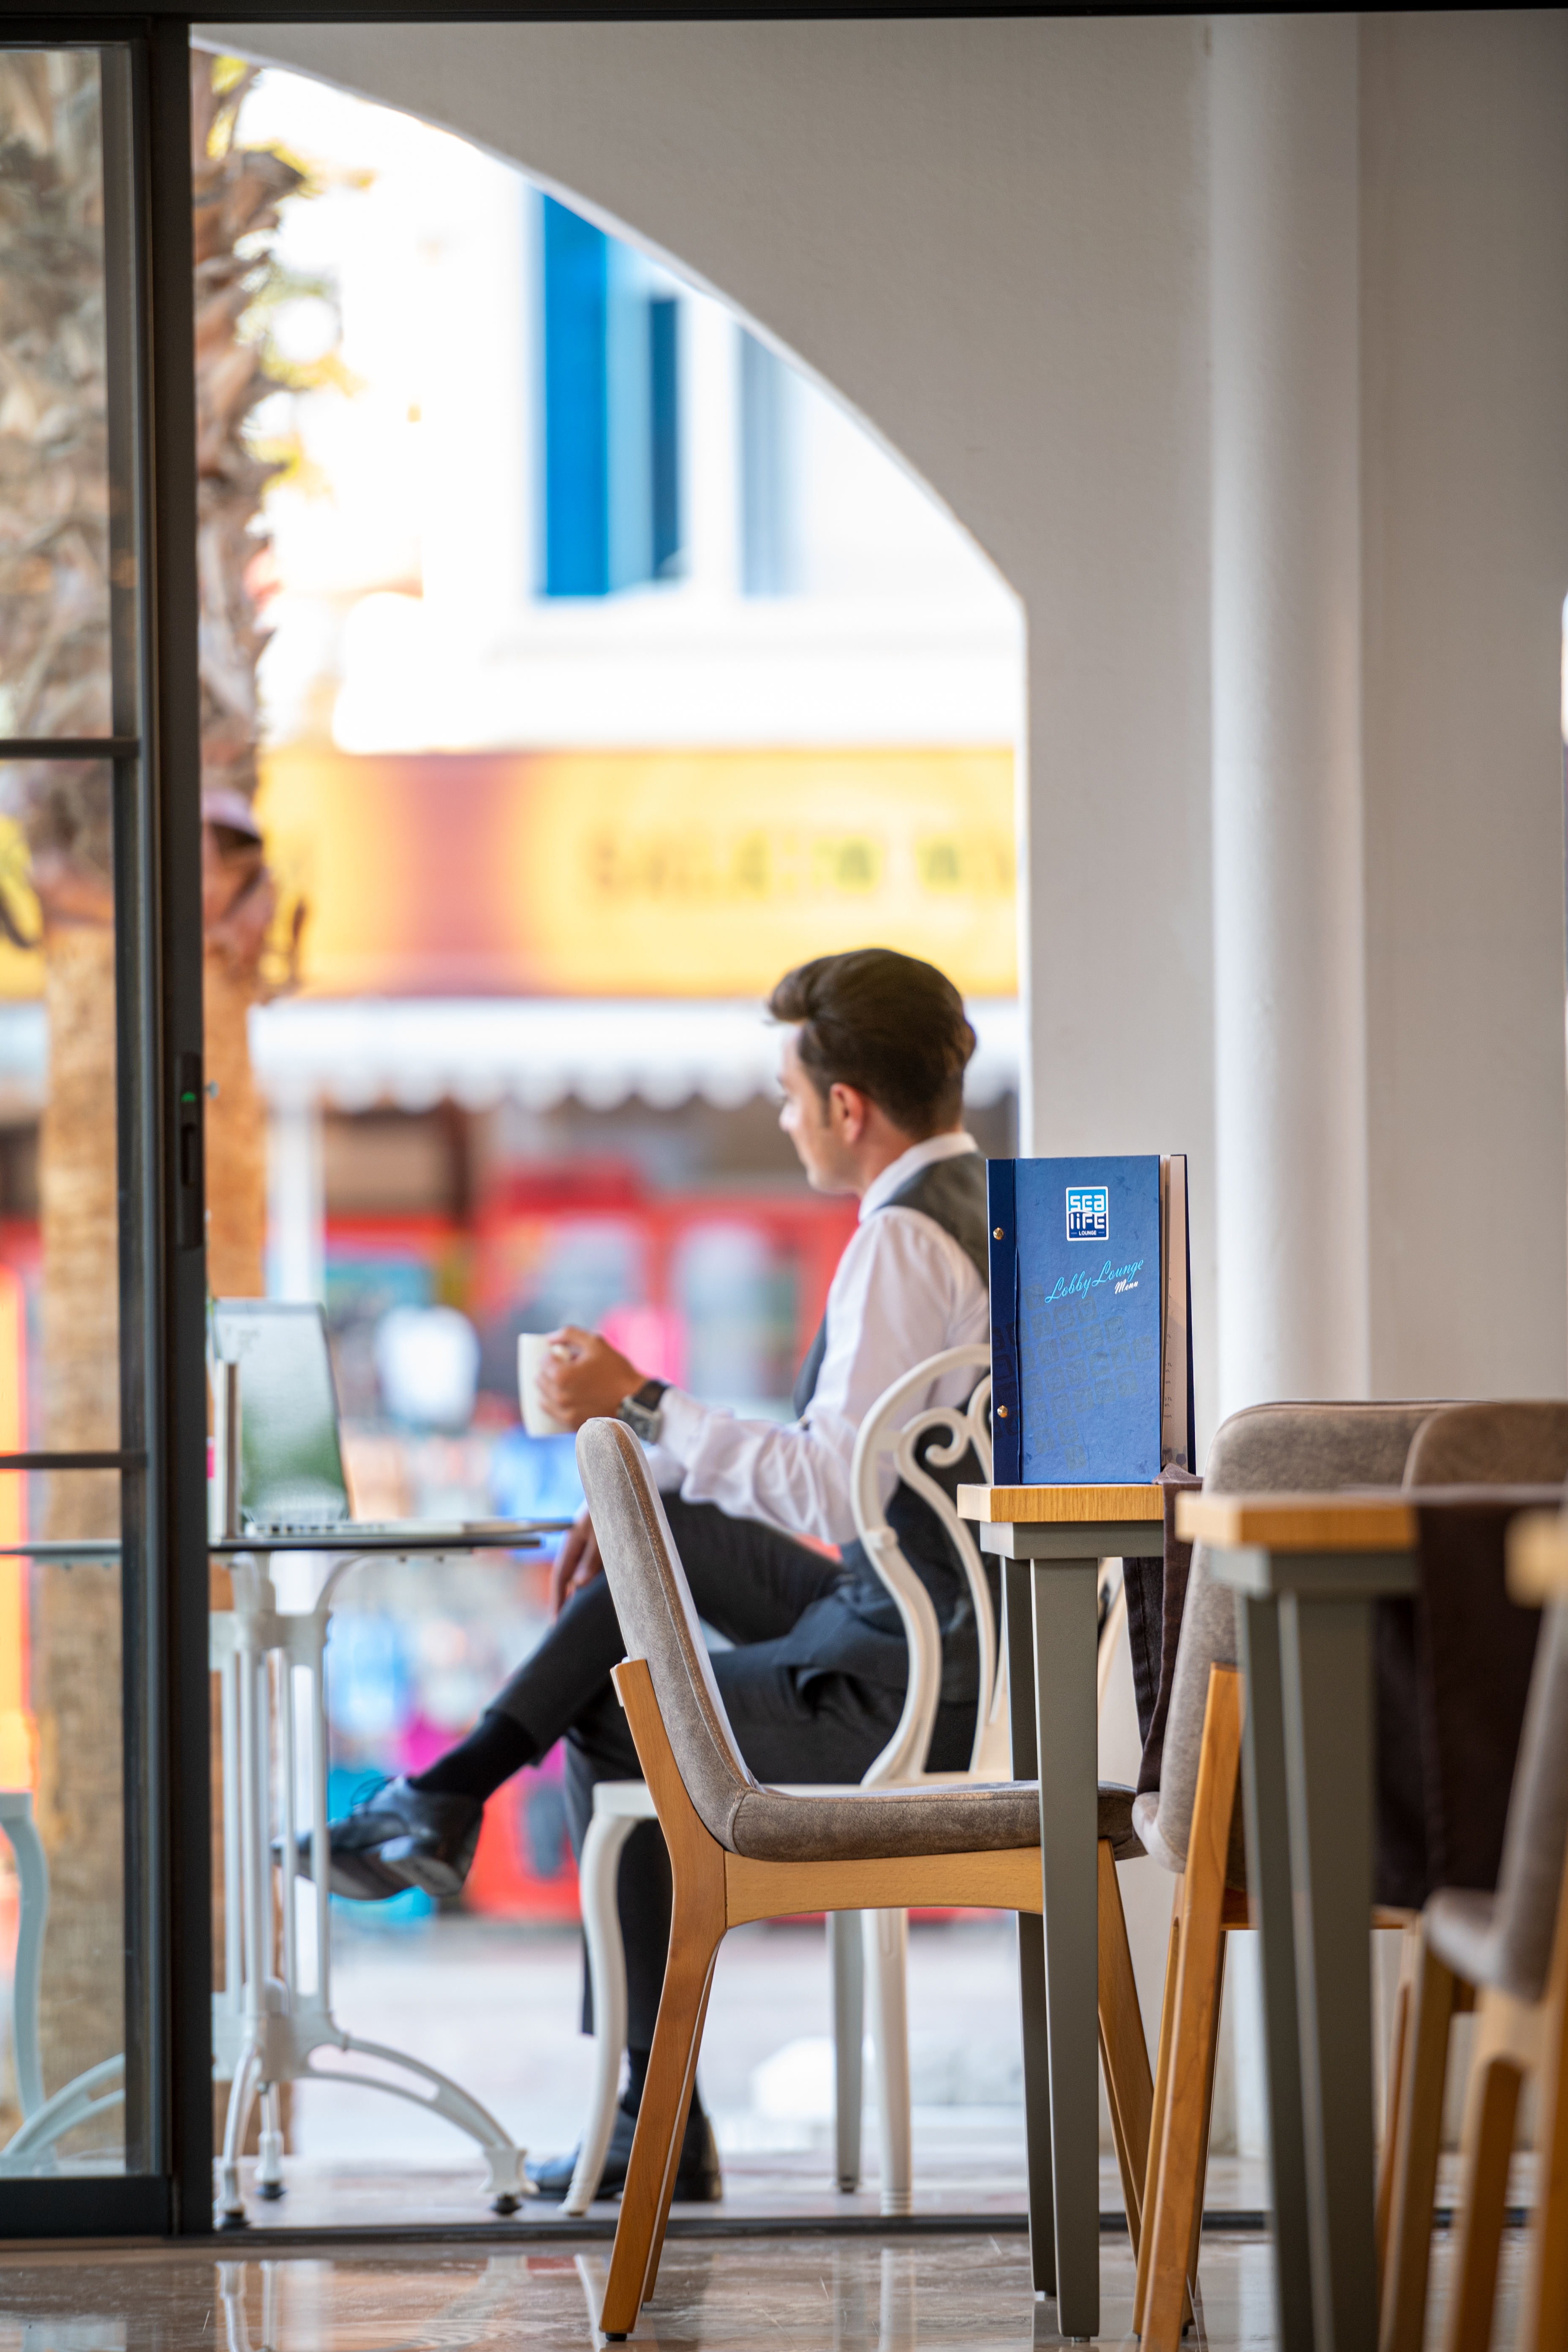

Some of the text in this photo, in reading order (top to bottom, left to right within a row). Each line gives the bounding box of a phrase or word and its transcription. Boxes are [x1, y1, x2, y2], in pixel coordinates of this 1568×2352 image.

[1045, 1259, 1143, 1304] Lobby Lounge
[1115, 1279, 1138, 1294] Menu
